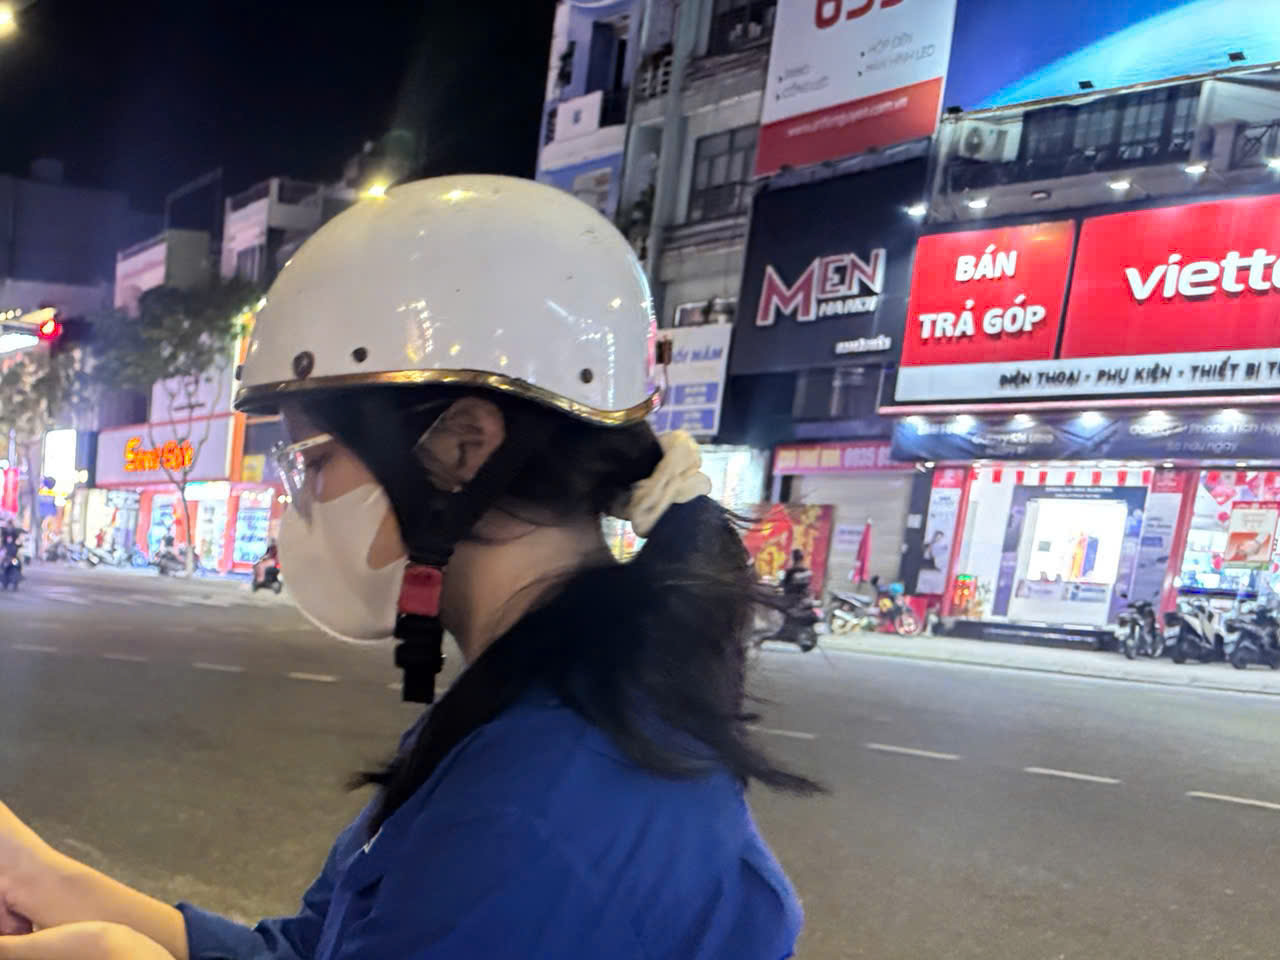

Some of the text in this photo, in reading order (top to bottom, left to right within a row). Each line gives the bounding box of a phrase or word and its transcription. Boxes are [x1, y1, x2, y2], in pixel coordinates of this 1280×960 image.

[955, 243, 1017, 282] BÁN
[1124, 248, 1280, 301] viett
[756, 248, 886, 326] MEN
[919, 299, 975, 339] TRẢ
[982, 294, 1046, 335] GÓP
[1096, 368, 1129, 386] PHỤ
